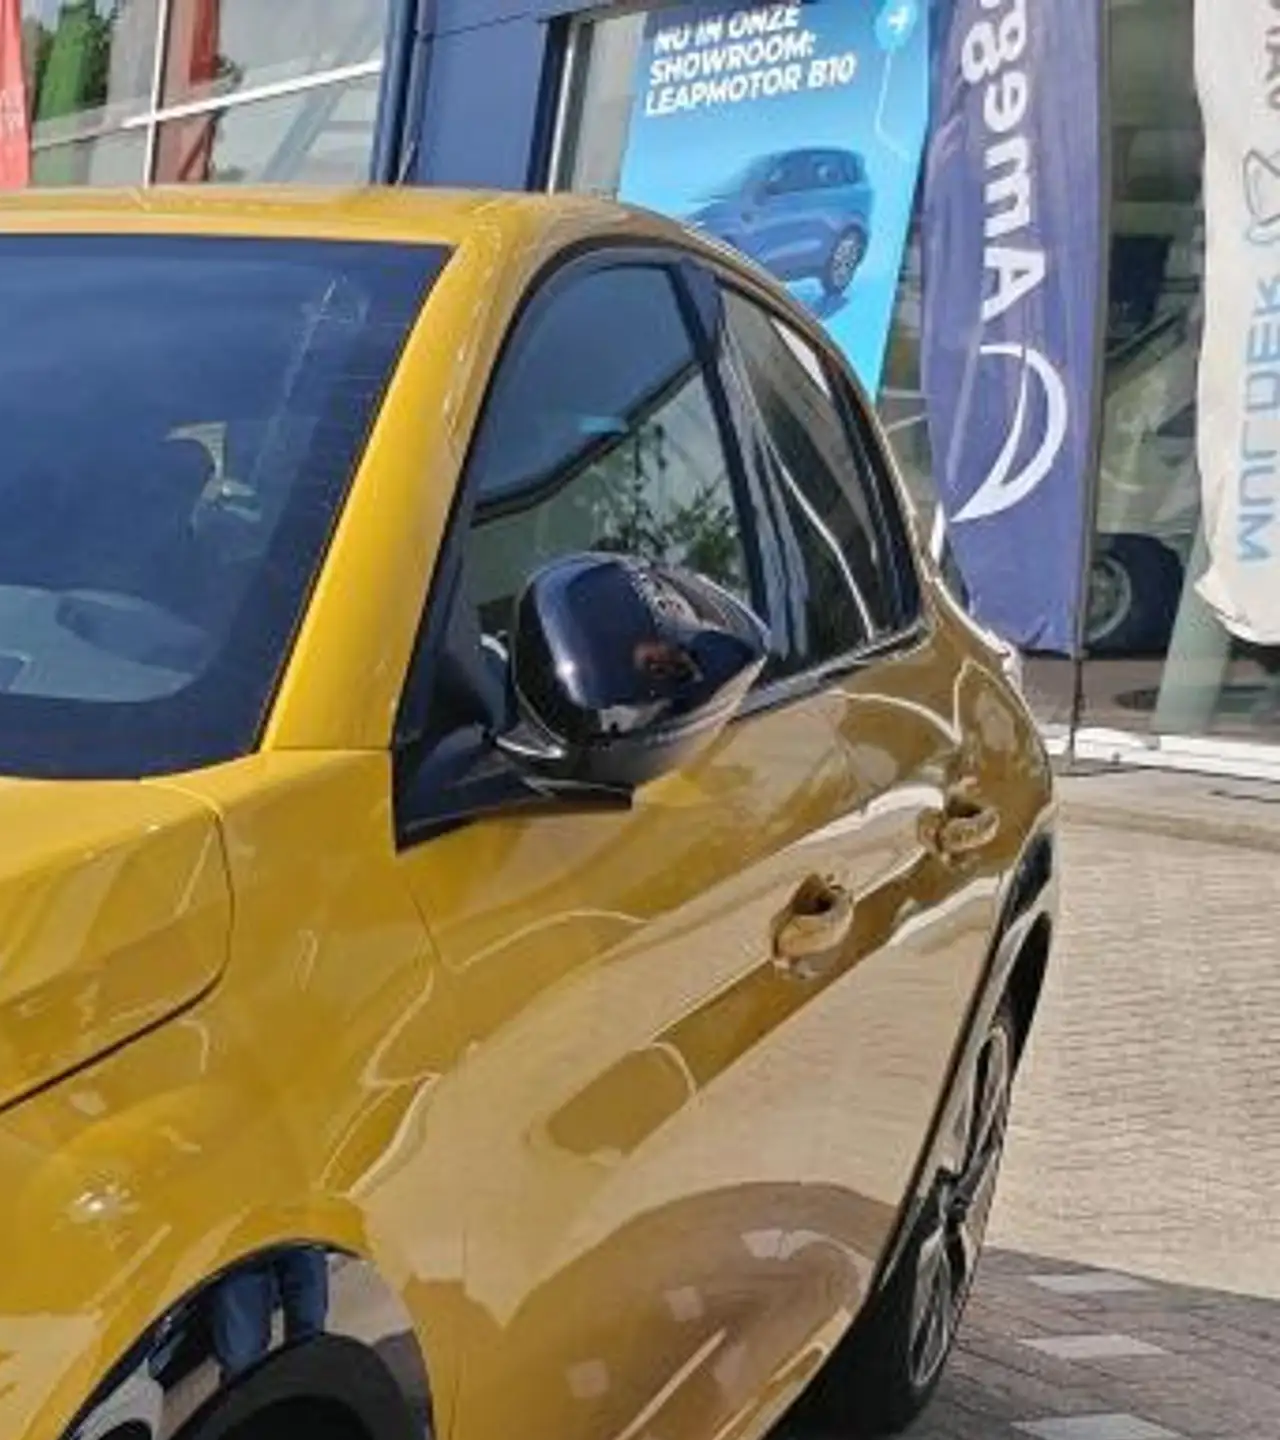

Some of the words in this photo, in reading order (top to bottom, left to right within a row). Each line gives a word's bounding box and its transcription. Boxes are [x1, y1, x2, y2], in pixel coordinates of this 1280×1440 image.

[649, 29, 816, 86] SHOWROOM:
[654, 24, 689, 53] NU
[695, 16, 723, 46] IN
[728, 5, 801, 38] ONZE
[645, 64, 803, 117] LEAPMOTOR
[808, 52, 857, 88] B10
